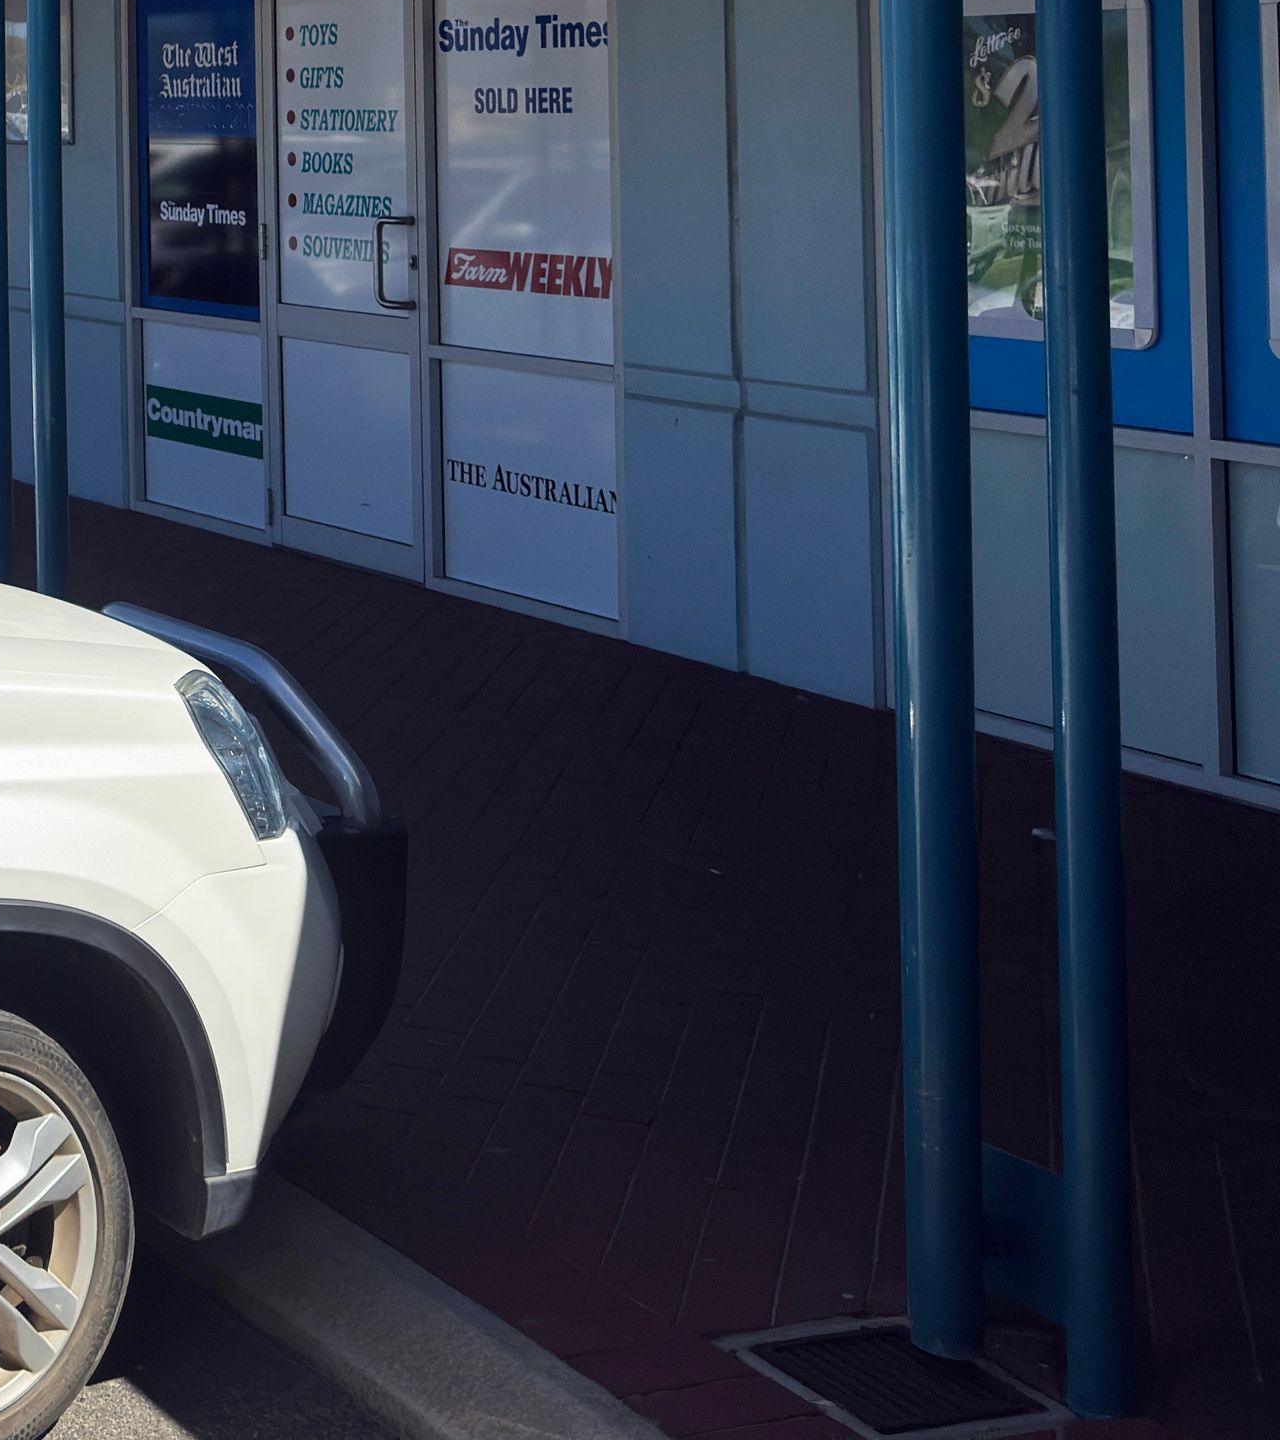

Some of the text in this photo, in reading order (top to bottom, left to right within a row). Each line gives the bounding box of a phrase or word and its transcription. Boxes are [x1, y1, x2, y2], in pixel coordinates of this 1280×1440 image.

[300, 24, 338, 47] TOYS
[439, 18, 530, 57] Sunday
[162, 40, 239, 69] The West
[159, 73, 242, 99] Australian
[300, 67, 344, 88] GIFTS
[474, 87, 573, 114] SOLD HERE
[300, 109, 398, 132] STATIONERY
[301, 151, 353, 174] BOOKS
[160, 200, 247, 227] Sunday Times
[302, 192, 392, 218] MAGAZINES
[450, 250, 613, 300] Farm WEEKLY
[447, 459, 487, 488] THE
